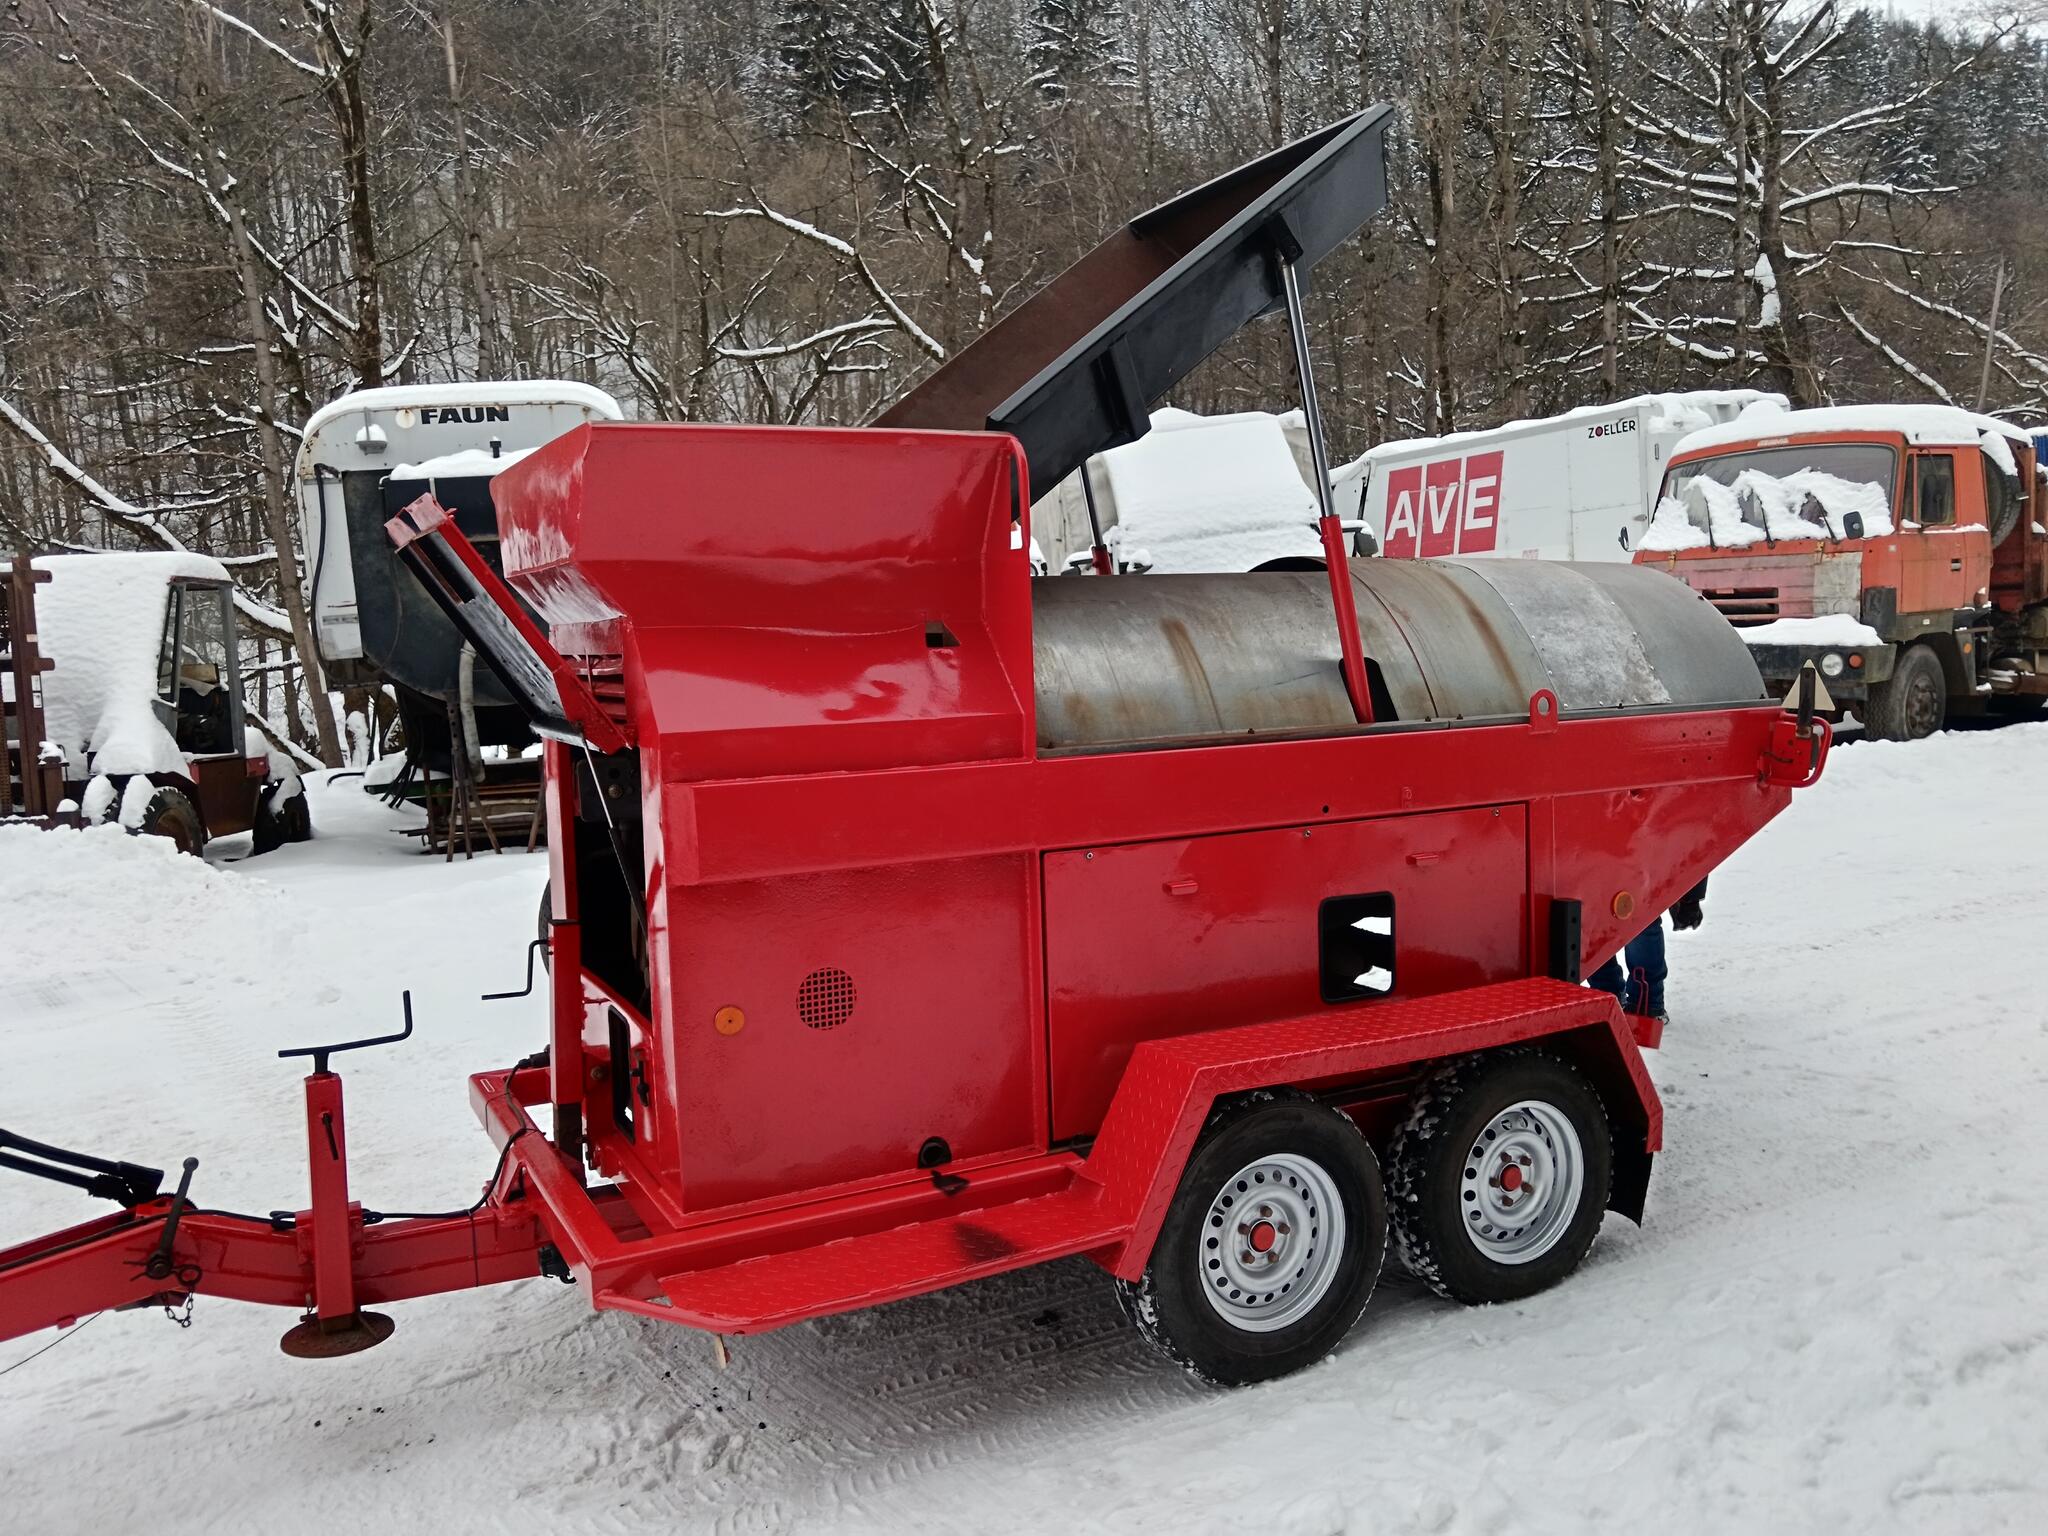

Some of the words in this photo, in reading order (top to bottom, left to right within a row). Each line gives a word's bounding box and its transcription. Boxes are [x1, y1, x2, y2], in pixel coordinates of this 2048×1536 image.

[420, 406, 509, 424] FAUN
[1588, 420, 1636, 438] ZOELLER
[1385, 475, 1497, 540] AVE
